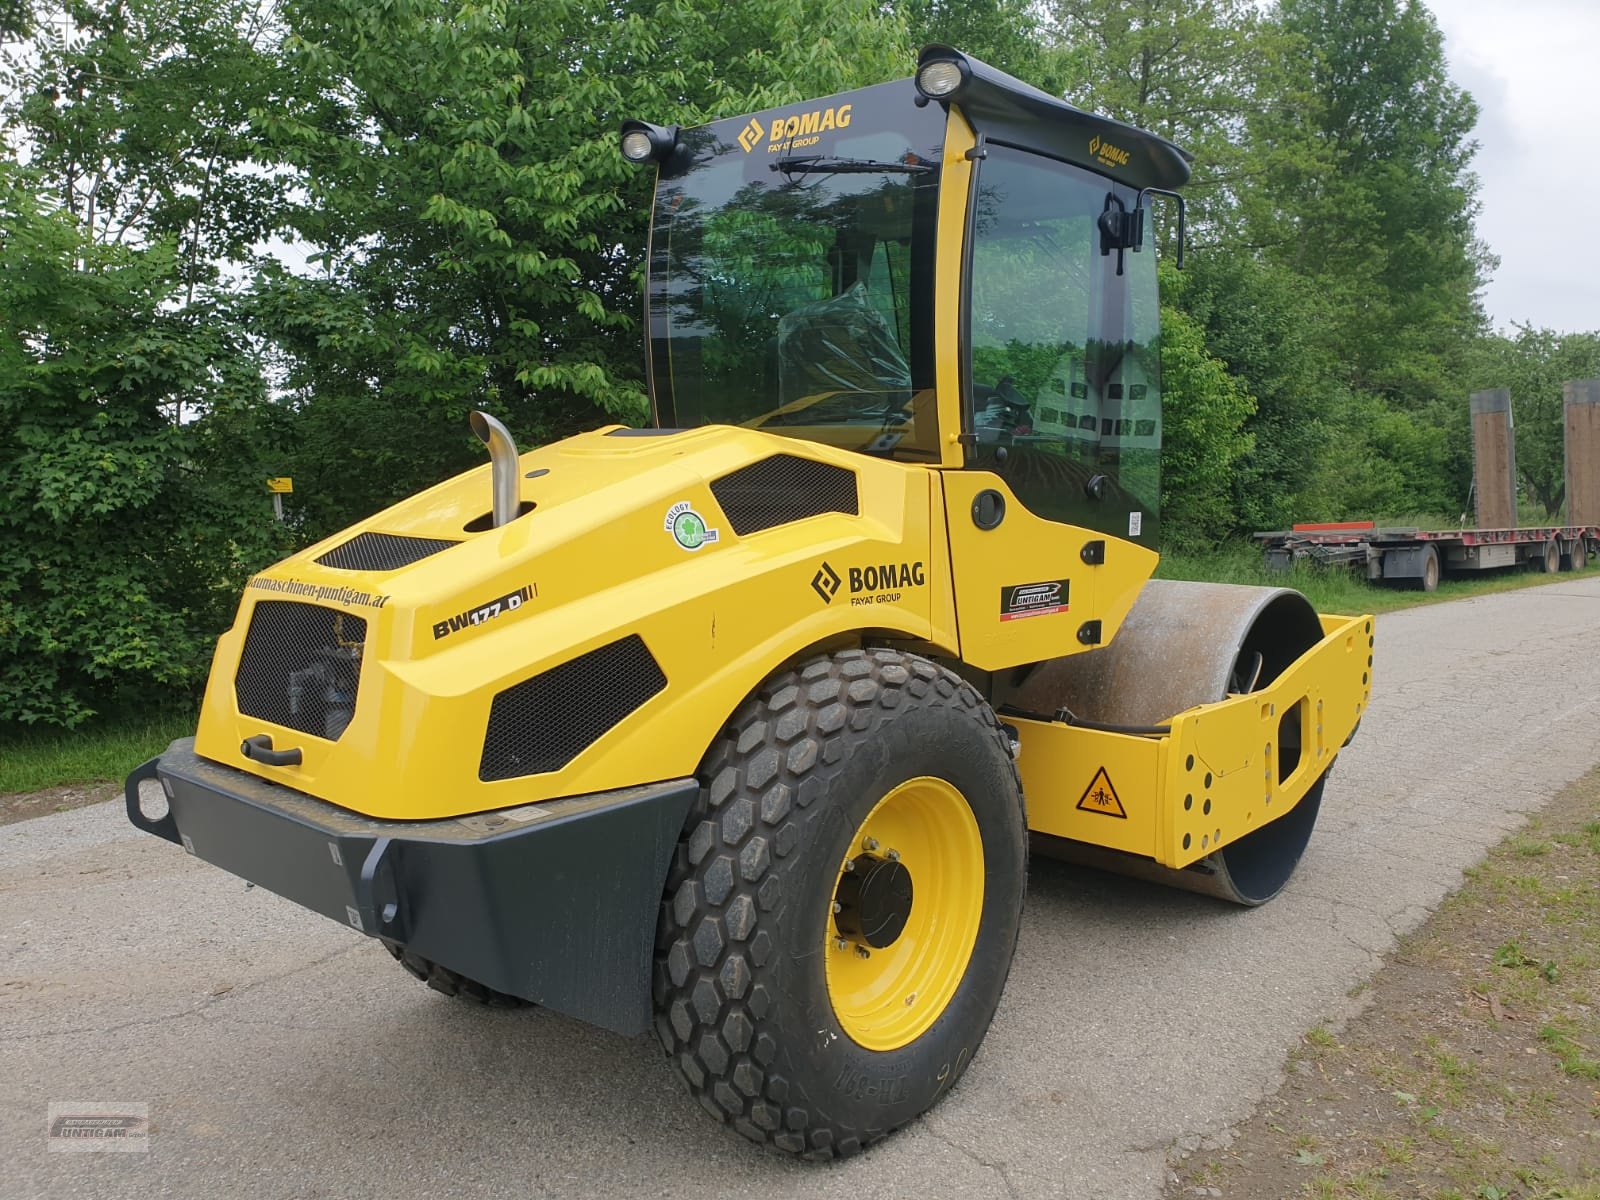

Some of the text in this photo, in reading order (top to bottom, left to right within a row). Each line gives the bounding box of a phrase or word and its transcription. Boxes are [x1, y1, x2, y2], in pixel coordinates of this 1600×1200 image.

[769, 104, 852, 142] BOMAG
[792, 136, 820, 148] GROUP
[1100, 143, 1130, 166] BOMAG
[665, 503, 689, 530] ECOLOGY
[848, 562, 925, 593] BOMAG
[850, 593, 901, 607] FAYAT GROUP
